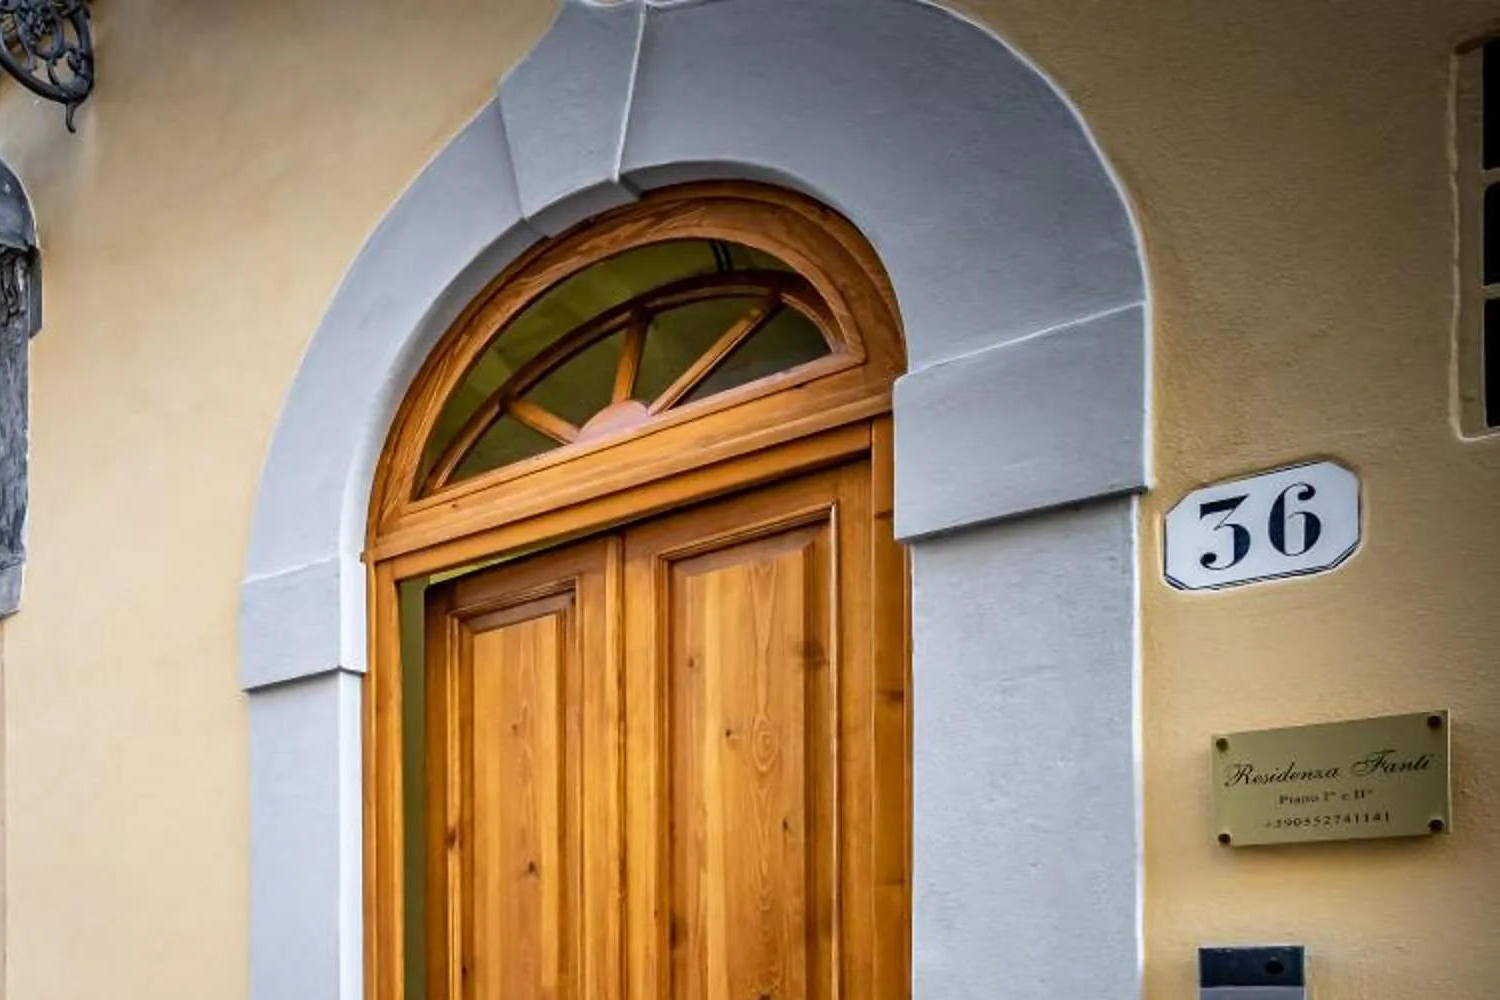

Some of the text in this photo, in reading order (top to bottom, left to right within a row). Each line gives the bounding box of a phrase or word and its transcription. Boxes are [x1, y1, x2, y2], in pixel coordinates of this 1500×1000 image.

[1199, 482, 1322, 571] 36
[1224, 750, 1438, 787] Residenza Fanti
[1279, 794, 1319, 805] Piano
